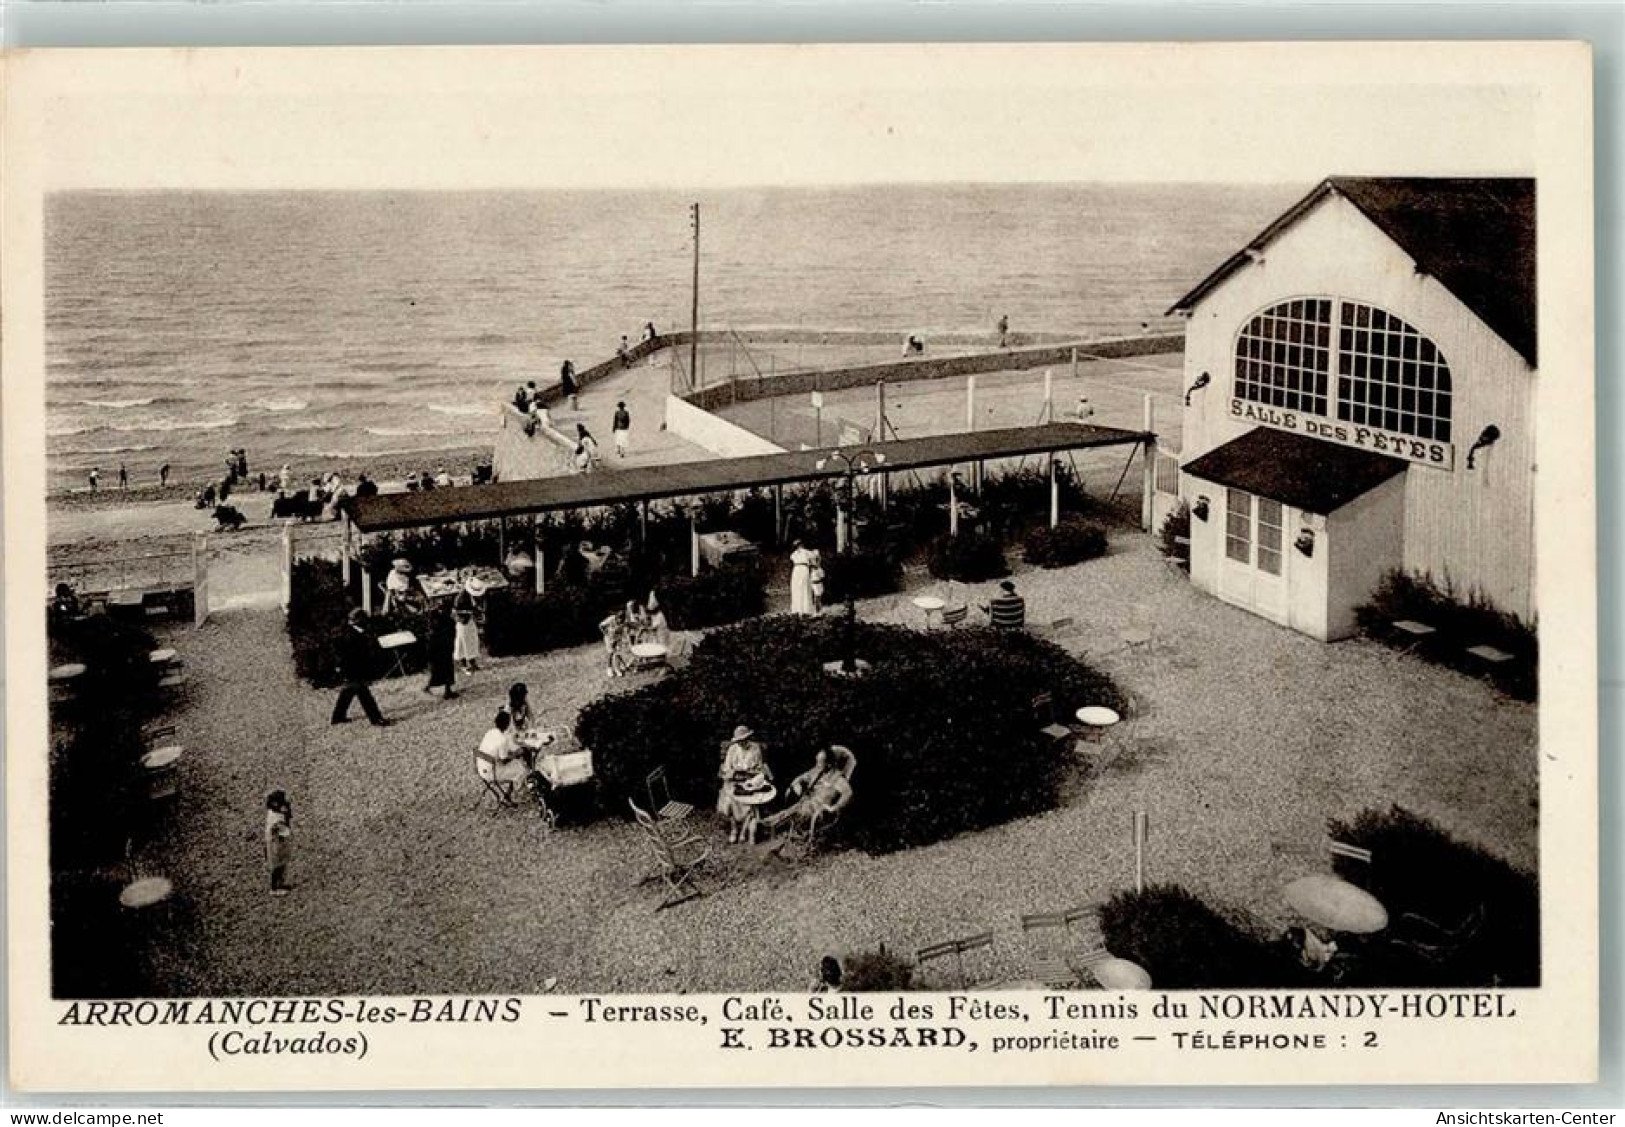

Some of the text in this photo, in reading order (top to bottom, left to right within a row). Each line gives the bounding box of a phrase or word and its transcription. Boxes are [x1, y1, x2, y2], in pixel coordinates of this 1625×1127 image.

[1231, 400, 1297, 429] SALLE
[1305, 419, 1348, 441] DES
[58, 998, 521, 1025] ARROMANCHES-les-BAINS
[580, 994, 708, 1024] Terrasse,
[808, 994, 874, 1021] Salle
[890, 995, 933, 1020] des
[949, 995, 1030, 1022] Fêtes,
[1044, 994, 1138, 1020] Tennis
[1153, 993, 1188, 1018] du
[1200, 993, 1517, 1019] NORMANDY-HOTEL
[208, 1030, 368, 1061] (Calvados)
[720, 1027, 754, 1051] E.
[768, 1027, 978, 1053] BROSSARD,
[992, 1028, 1119, 1053] propriétaire
[1172, 1030, 1326, 1049] TÉLÉPHONE
[1364, 1031, 1378, 1048] 2
